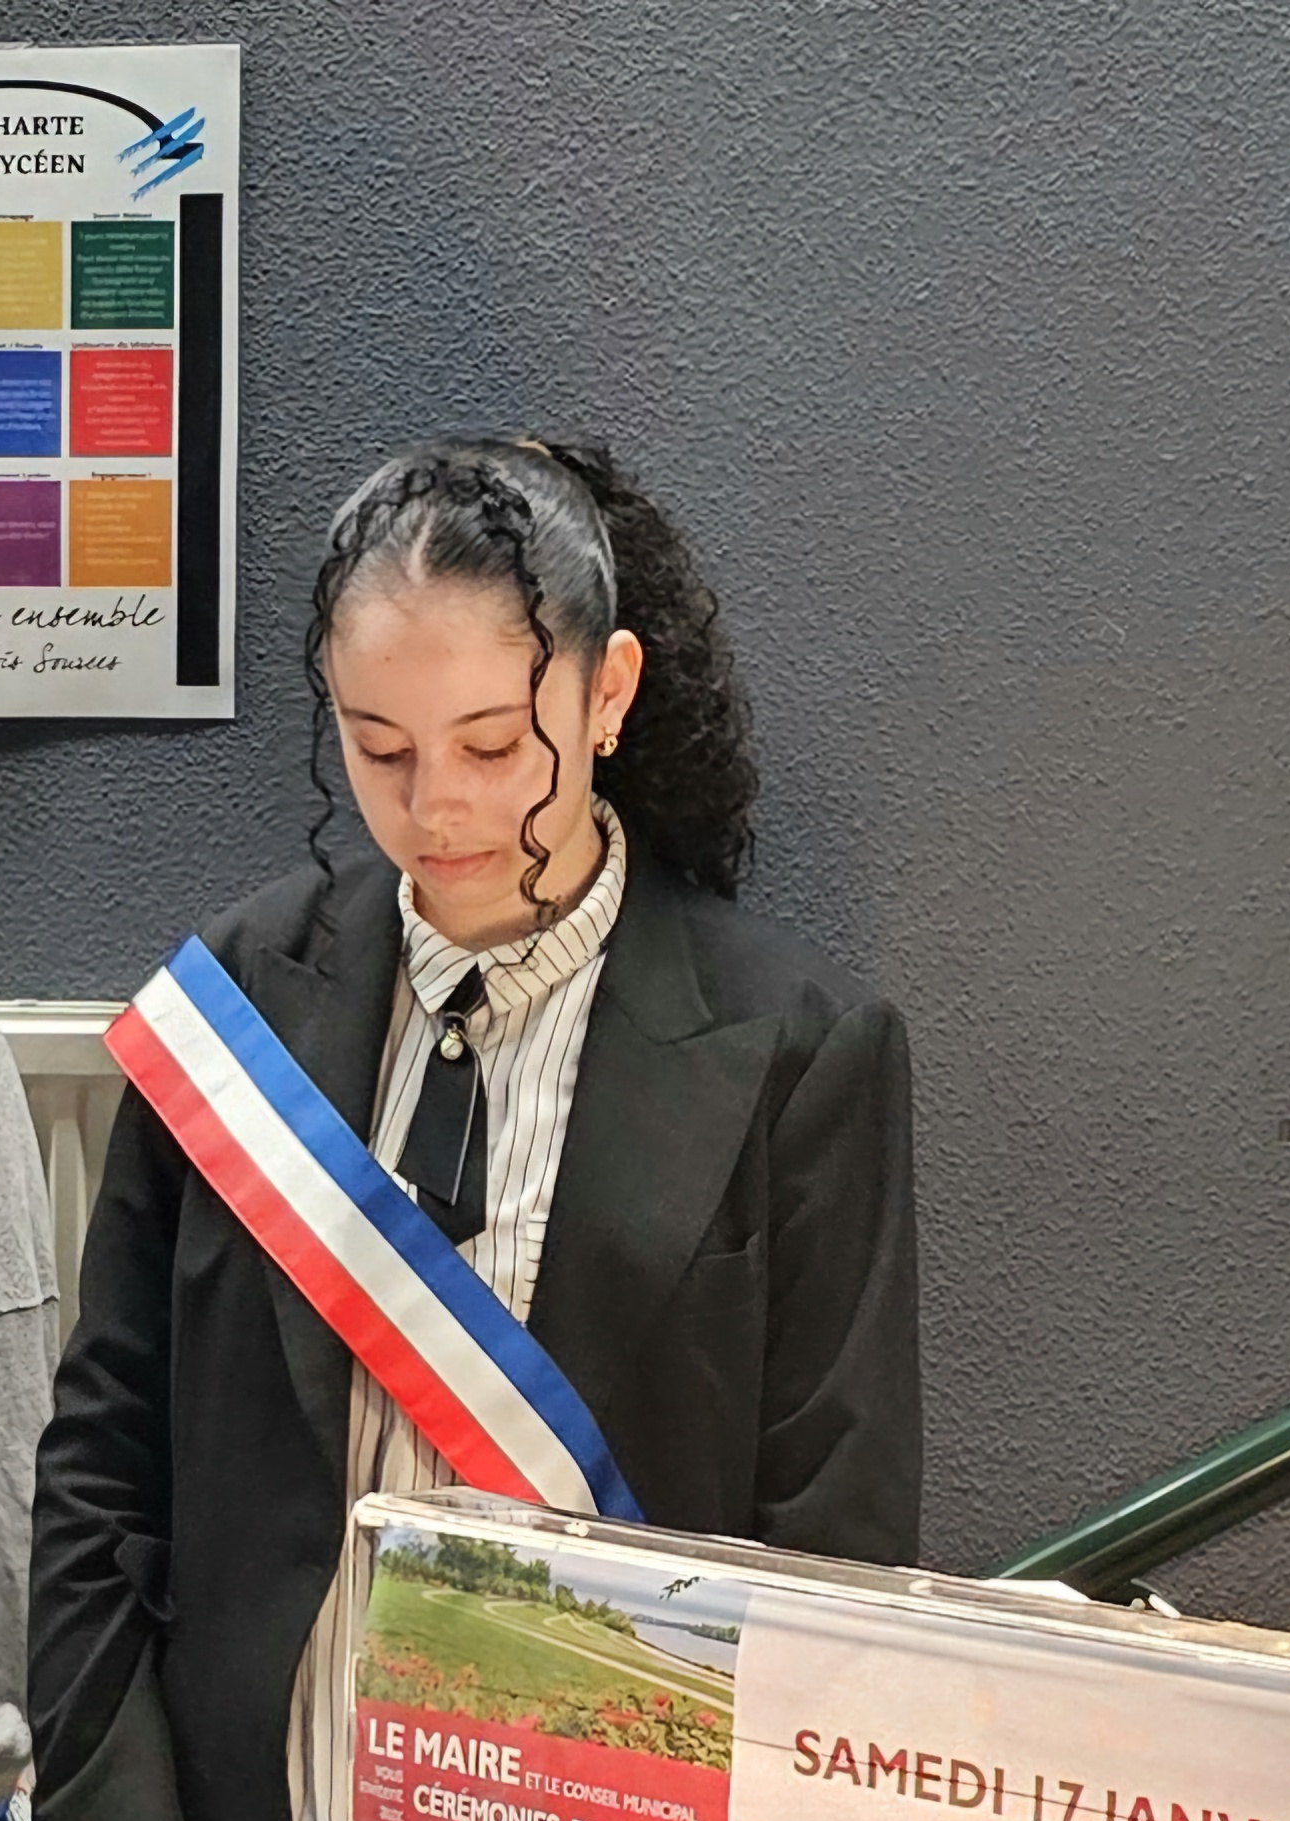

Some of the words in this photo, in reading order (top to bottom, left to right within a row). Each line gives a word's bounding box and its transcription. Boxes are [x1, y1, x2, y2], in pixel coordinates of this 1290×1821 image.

[11, 594, 165, 628] ensemble
[33, 642, 122, 673] Sources
[368, 1718, 405, 1760] LE
[414, 1727, 522, 1786] MAIRE
[525, 1771, 542, 1789] ET
[545, 1776, 561, 1795] LE
[563, 1781, 620, 1810] CONSEIL
[794, 1729, 1004, 1815] SAMEDI
